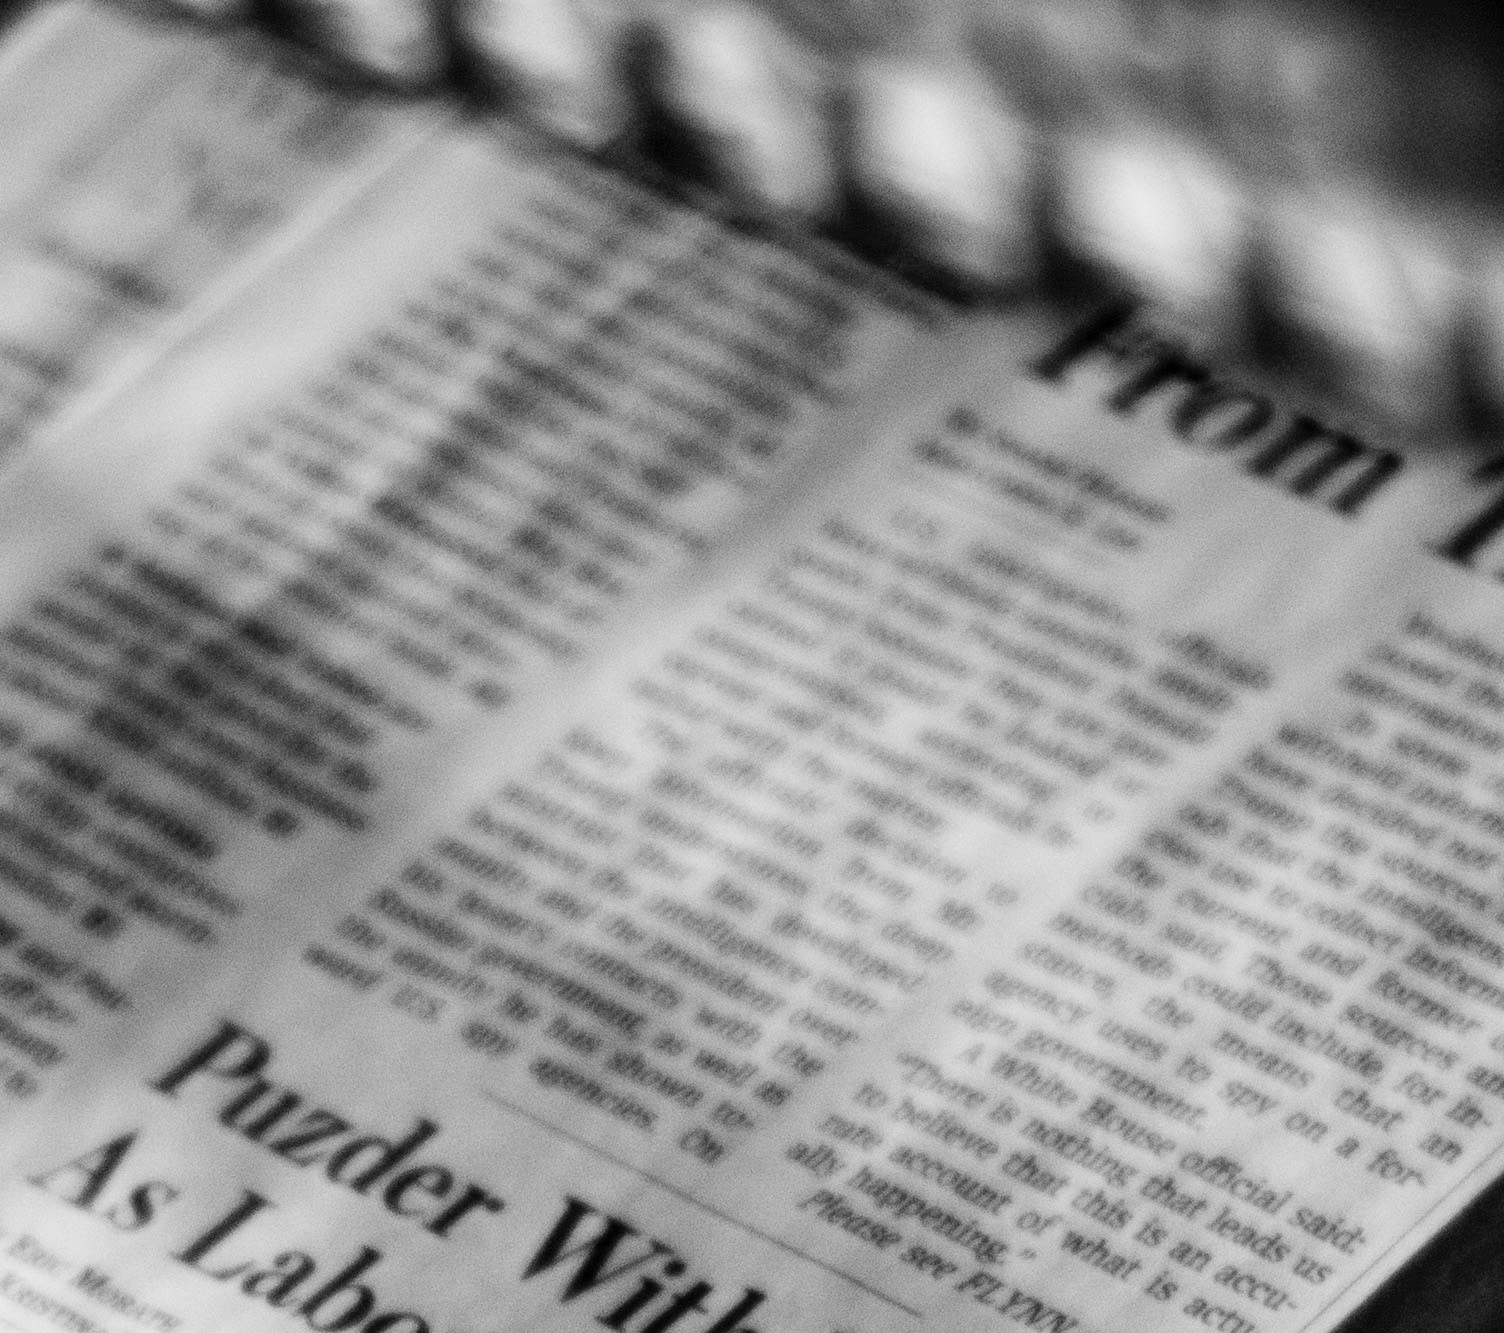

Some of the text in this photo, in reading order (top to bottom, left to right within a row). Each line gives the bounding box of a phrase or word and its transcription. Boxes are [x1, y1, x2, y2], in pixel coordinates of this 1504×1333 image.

[1028, 289, 1407, 519] From
[22, 1129, 180, 1235] As
[146, 1019, 505, 1245] Puzder
